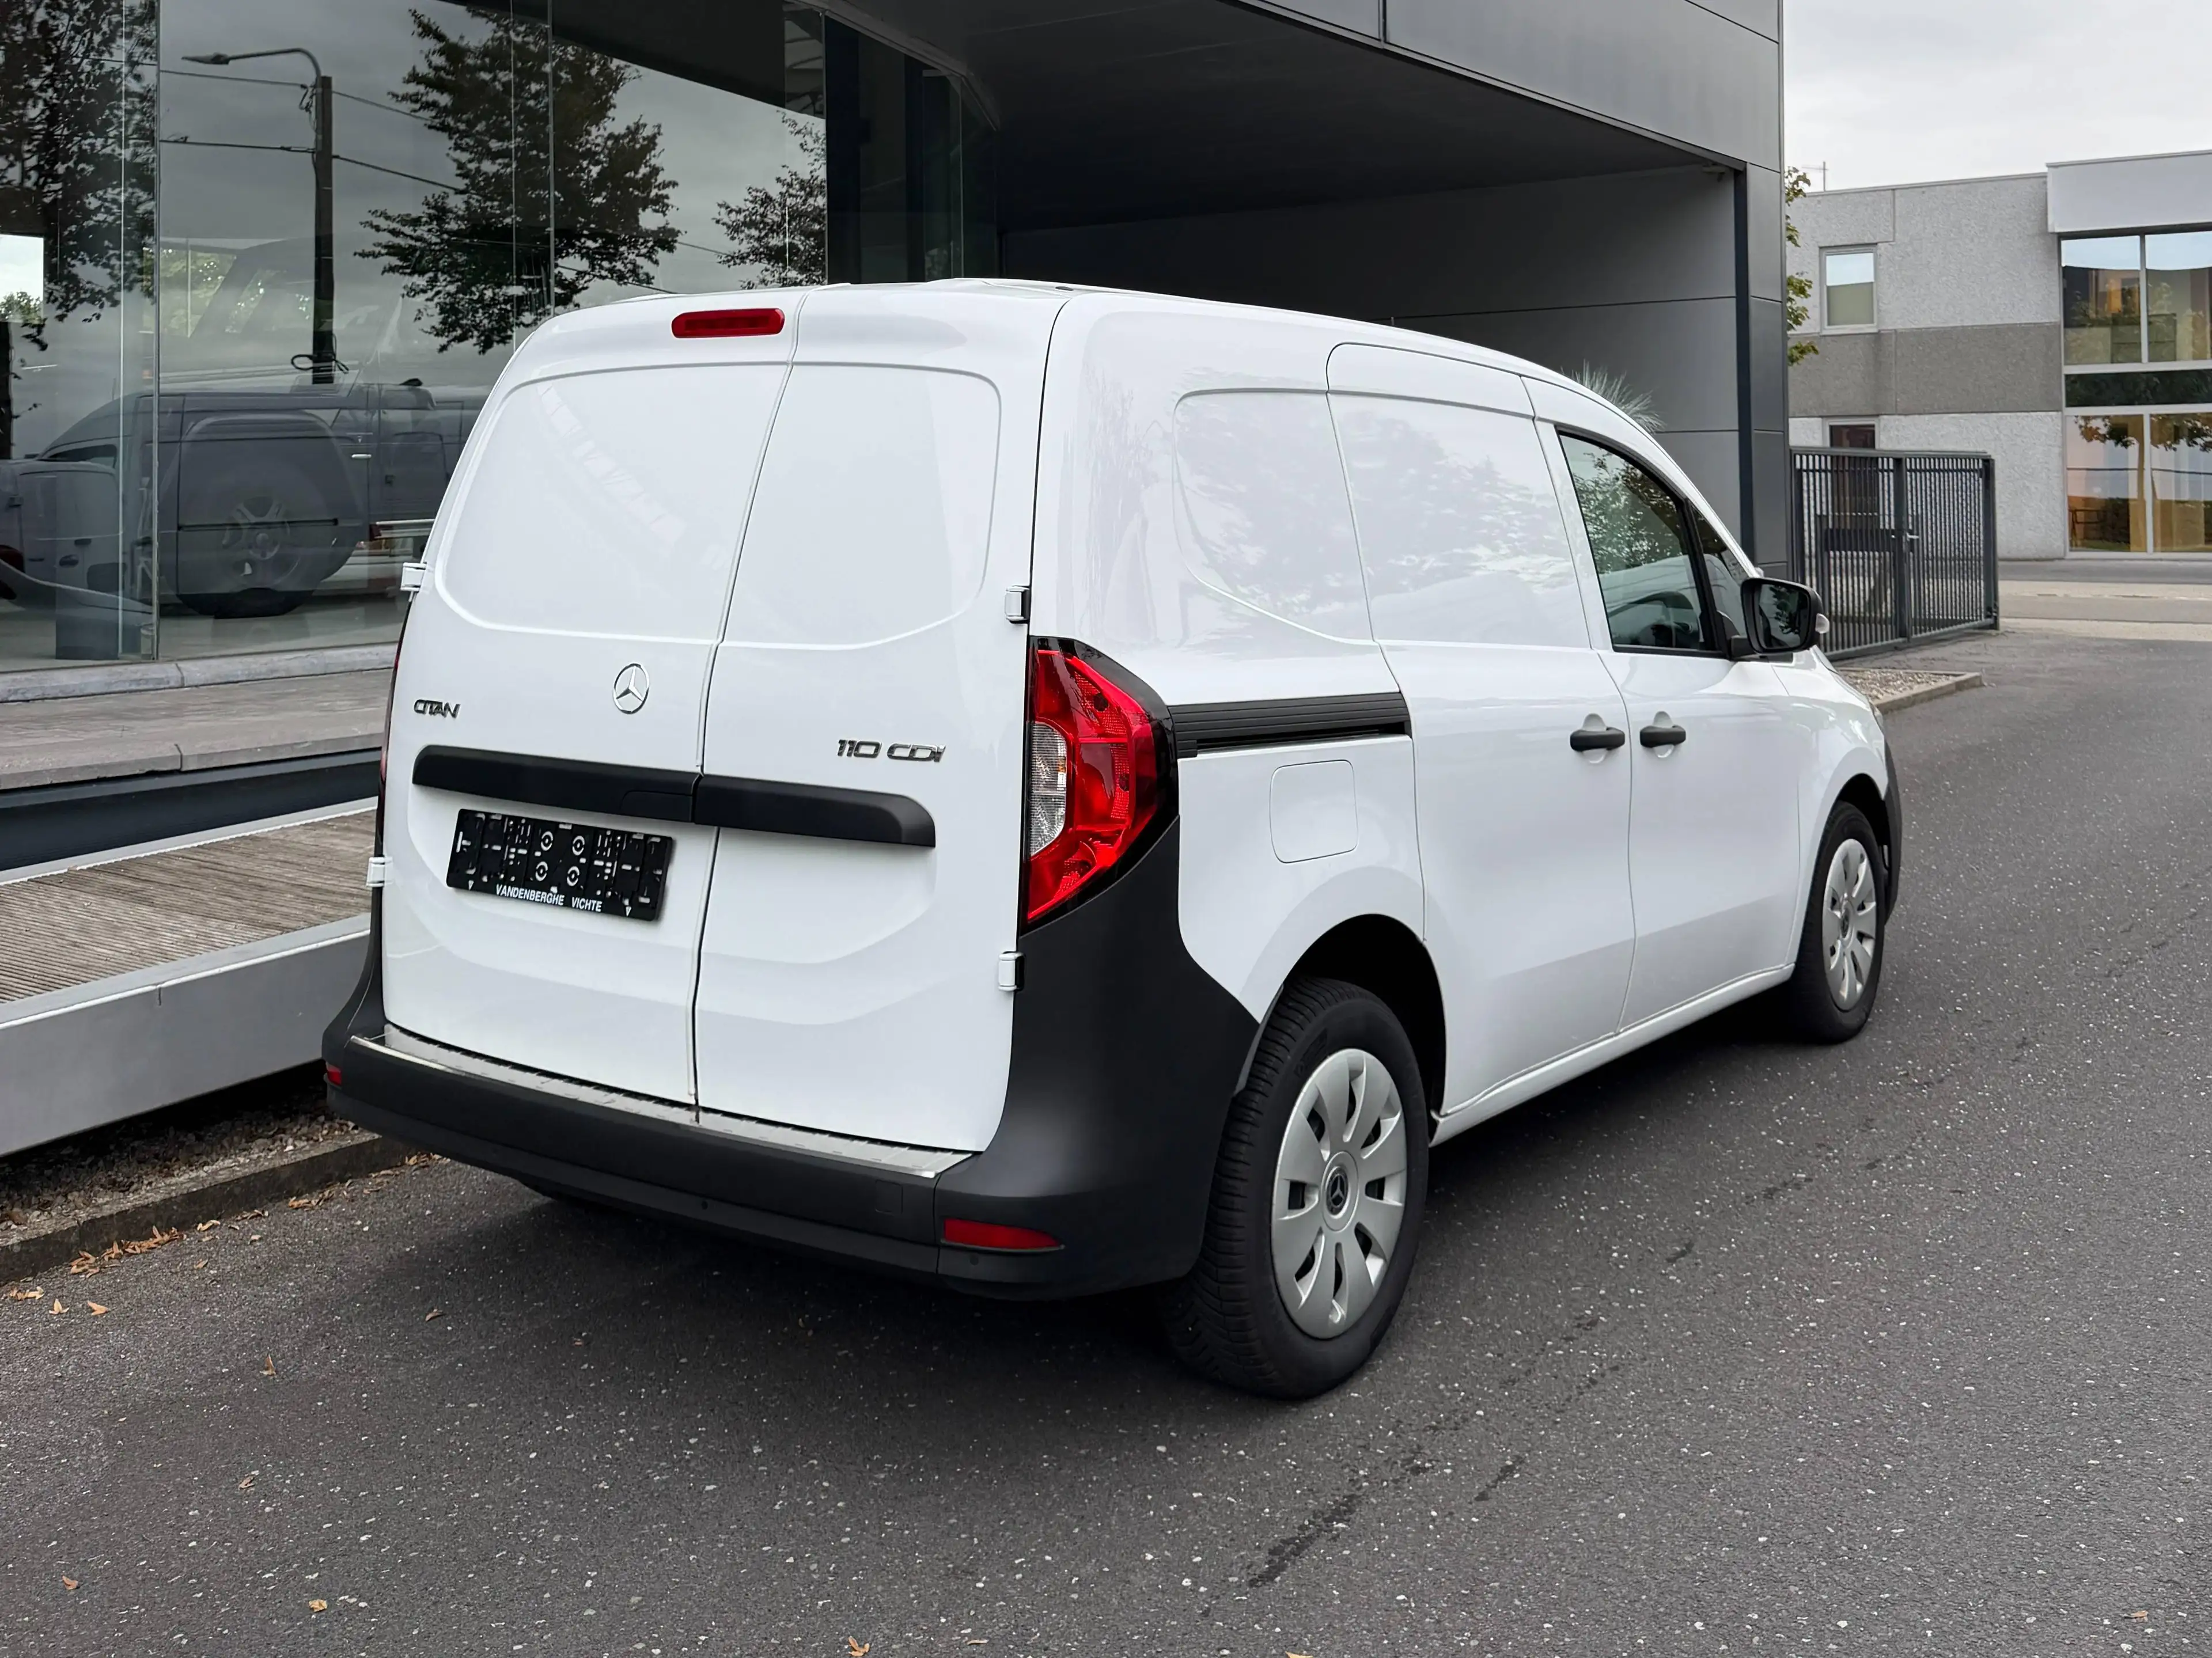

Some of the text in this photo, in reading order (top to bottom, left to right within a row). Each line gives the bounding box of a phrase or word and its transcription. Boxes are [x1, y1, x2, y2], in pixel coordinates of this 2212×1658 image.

[414, 699, 461, 718] CITAN
[837, 739, 882, 758] 110
[496, 884, 603, 912] VANDENBERGHE VICHTE
